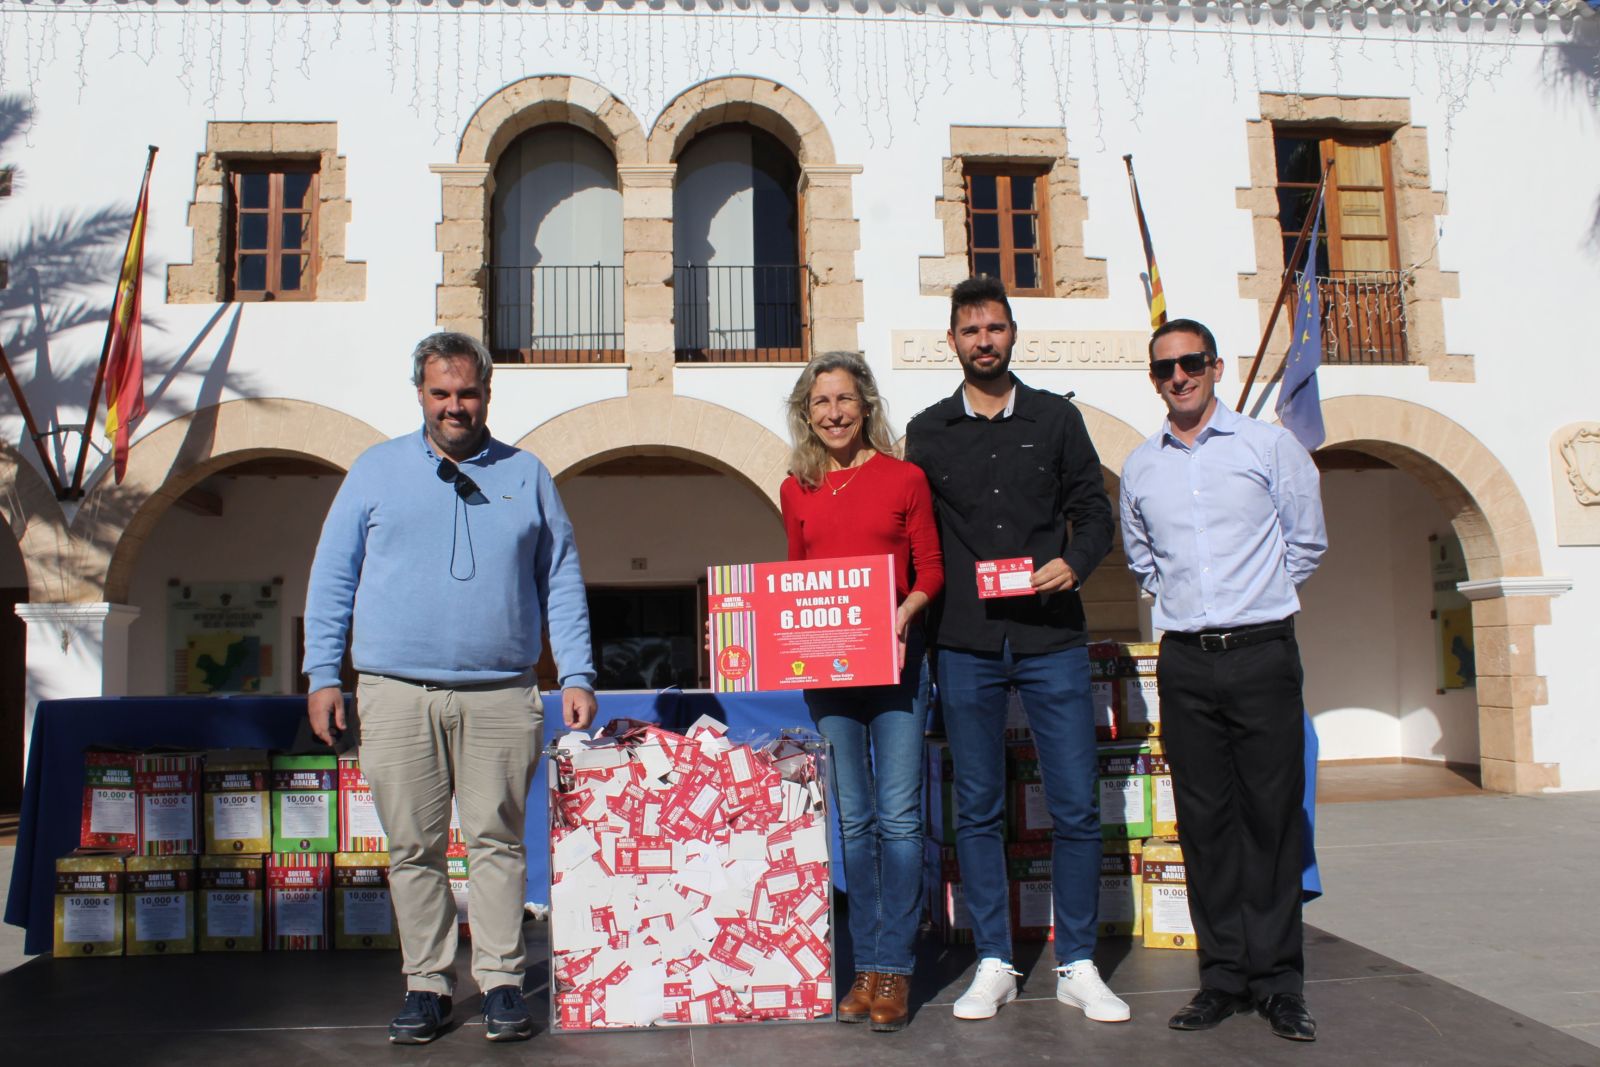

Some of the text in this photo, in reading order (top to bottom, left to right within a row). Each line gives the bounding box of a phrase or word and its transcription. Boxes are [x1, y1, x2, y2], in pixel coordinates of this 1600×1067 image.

[767, 568, 872, 593] 1 GRAN LOT
[796, 595, 849, 607] VALORAT EN
[780, 606, 862, 629] 6.000 €
[290, 779, 320, 787] NADALENC
[97, 791, 126, 799] 10.000
[286, 795, 324, 803] 10.000 €
[149, 797, 179, 805] 10.000
[218, 796, 248, 804] 10.000
[70, 898, 100, 906] 10.000
